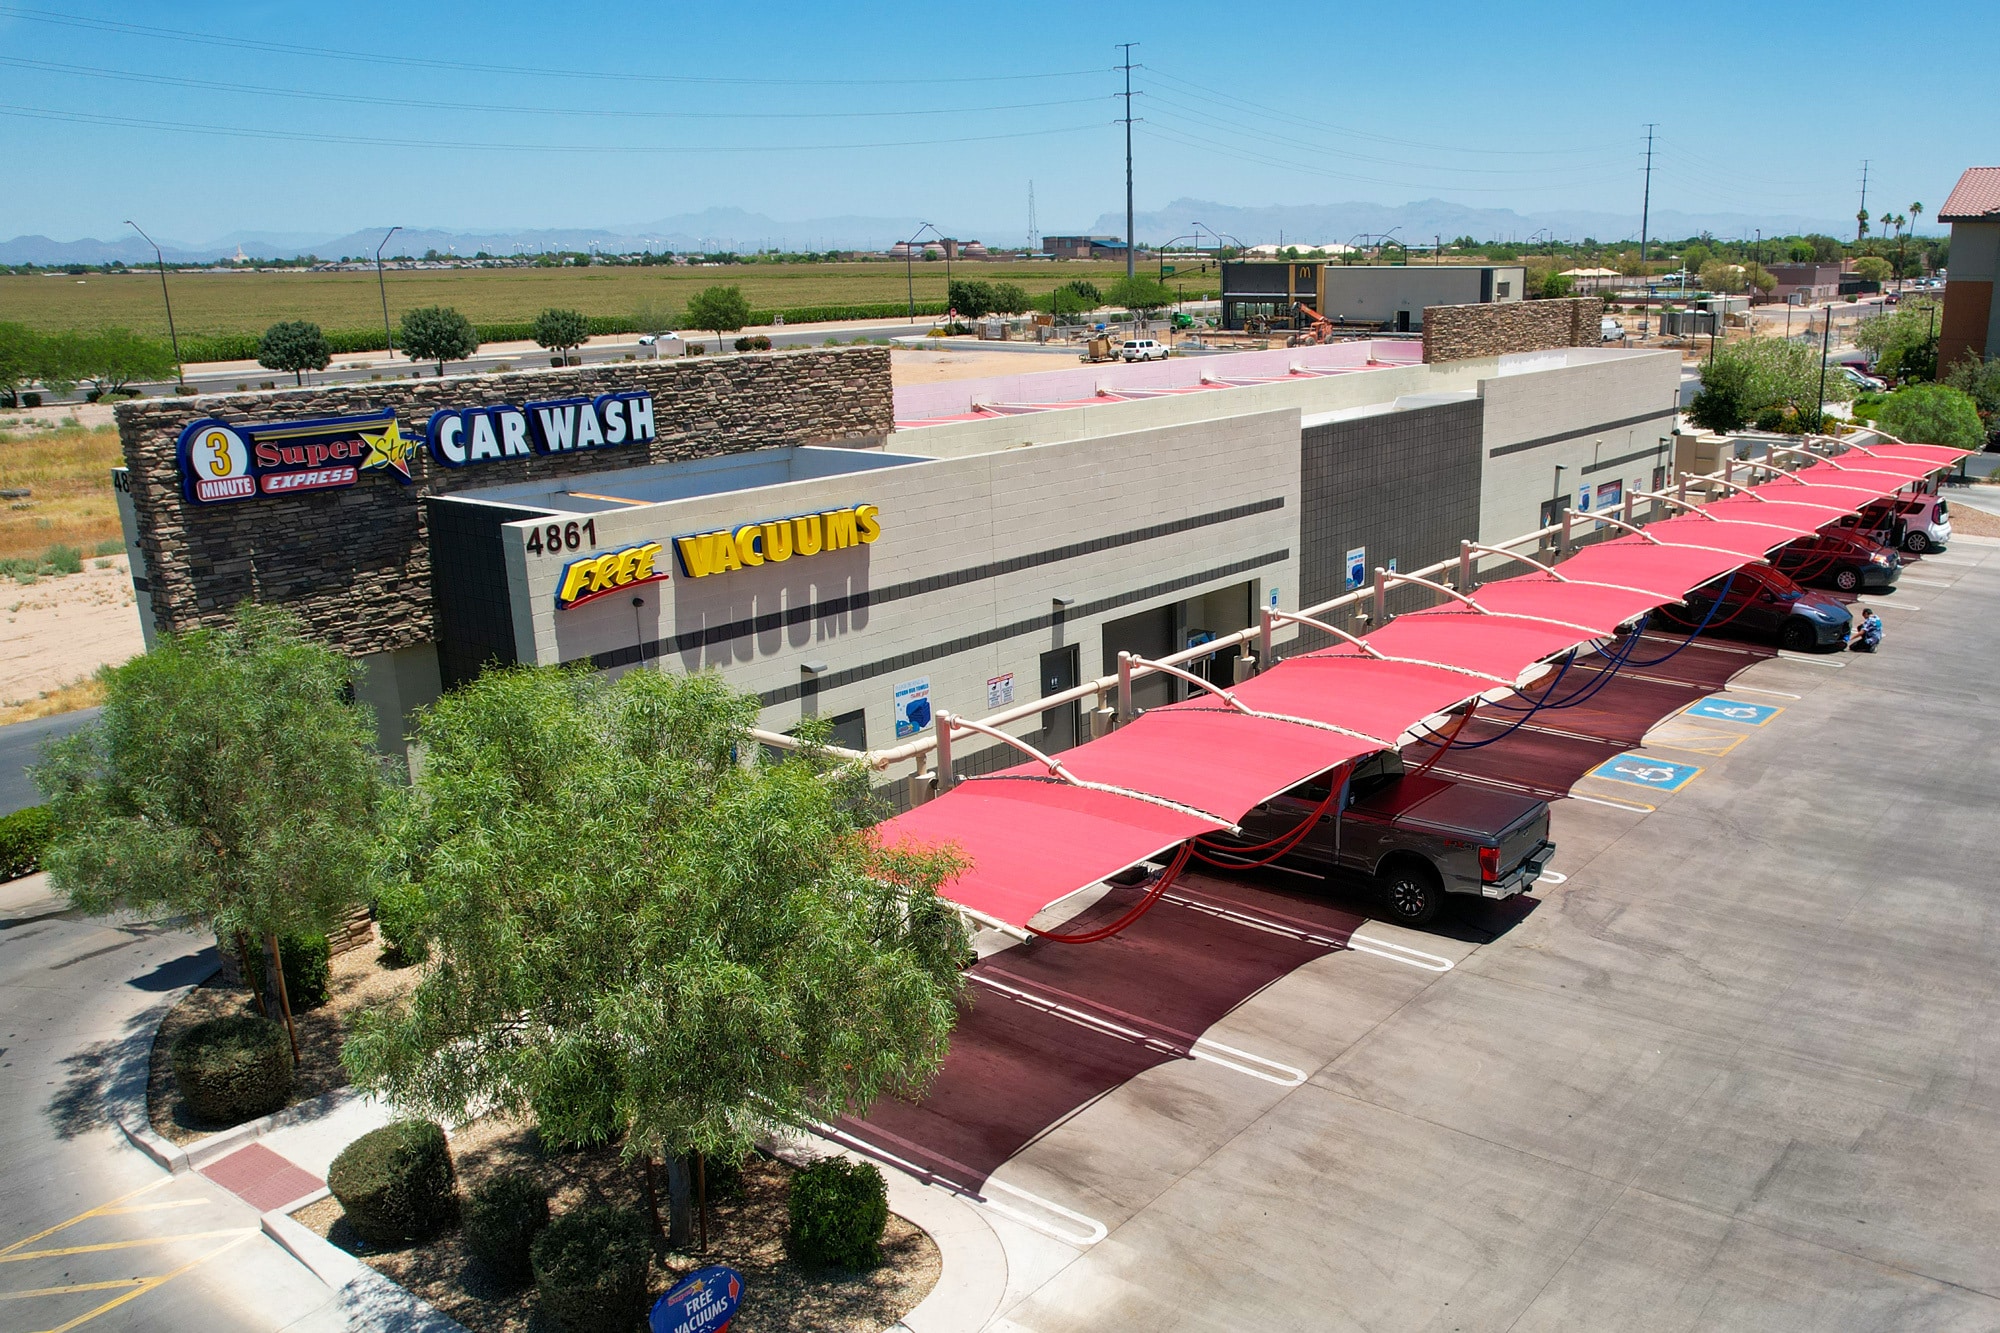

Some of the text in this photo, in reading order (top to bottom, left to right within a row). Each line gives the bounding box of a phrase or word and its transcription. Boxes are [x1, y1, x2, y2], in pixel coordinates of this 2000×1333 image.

[440, 398, 656, 462] CAR WASH
[206, 432, 233, 477] 3
[255, 437, 420, 469] Super Star
[201, 478, 252, 499] MINUTE
[266, 467, 355, 490] EXPRESS
[526, 518, 597, 555] 4861
[559, 504, 881, 602] FREE VACUUMS
[674, 1296, 728, 1333] VACUUMS
[685, 1288, 713, 1317] FREE
